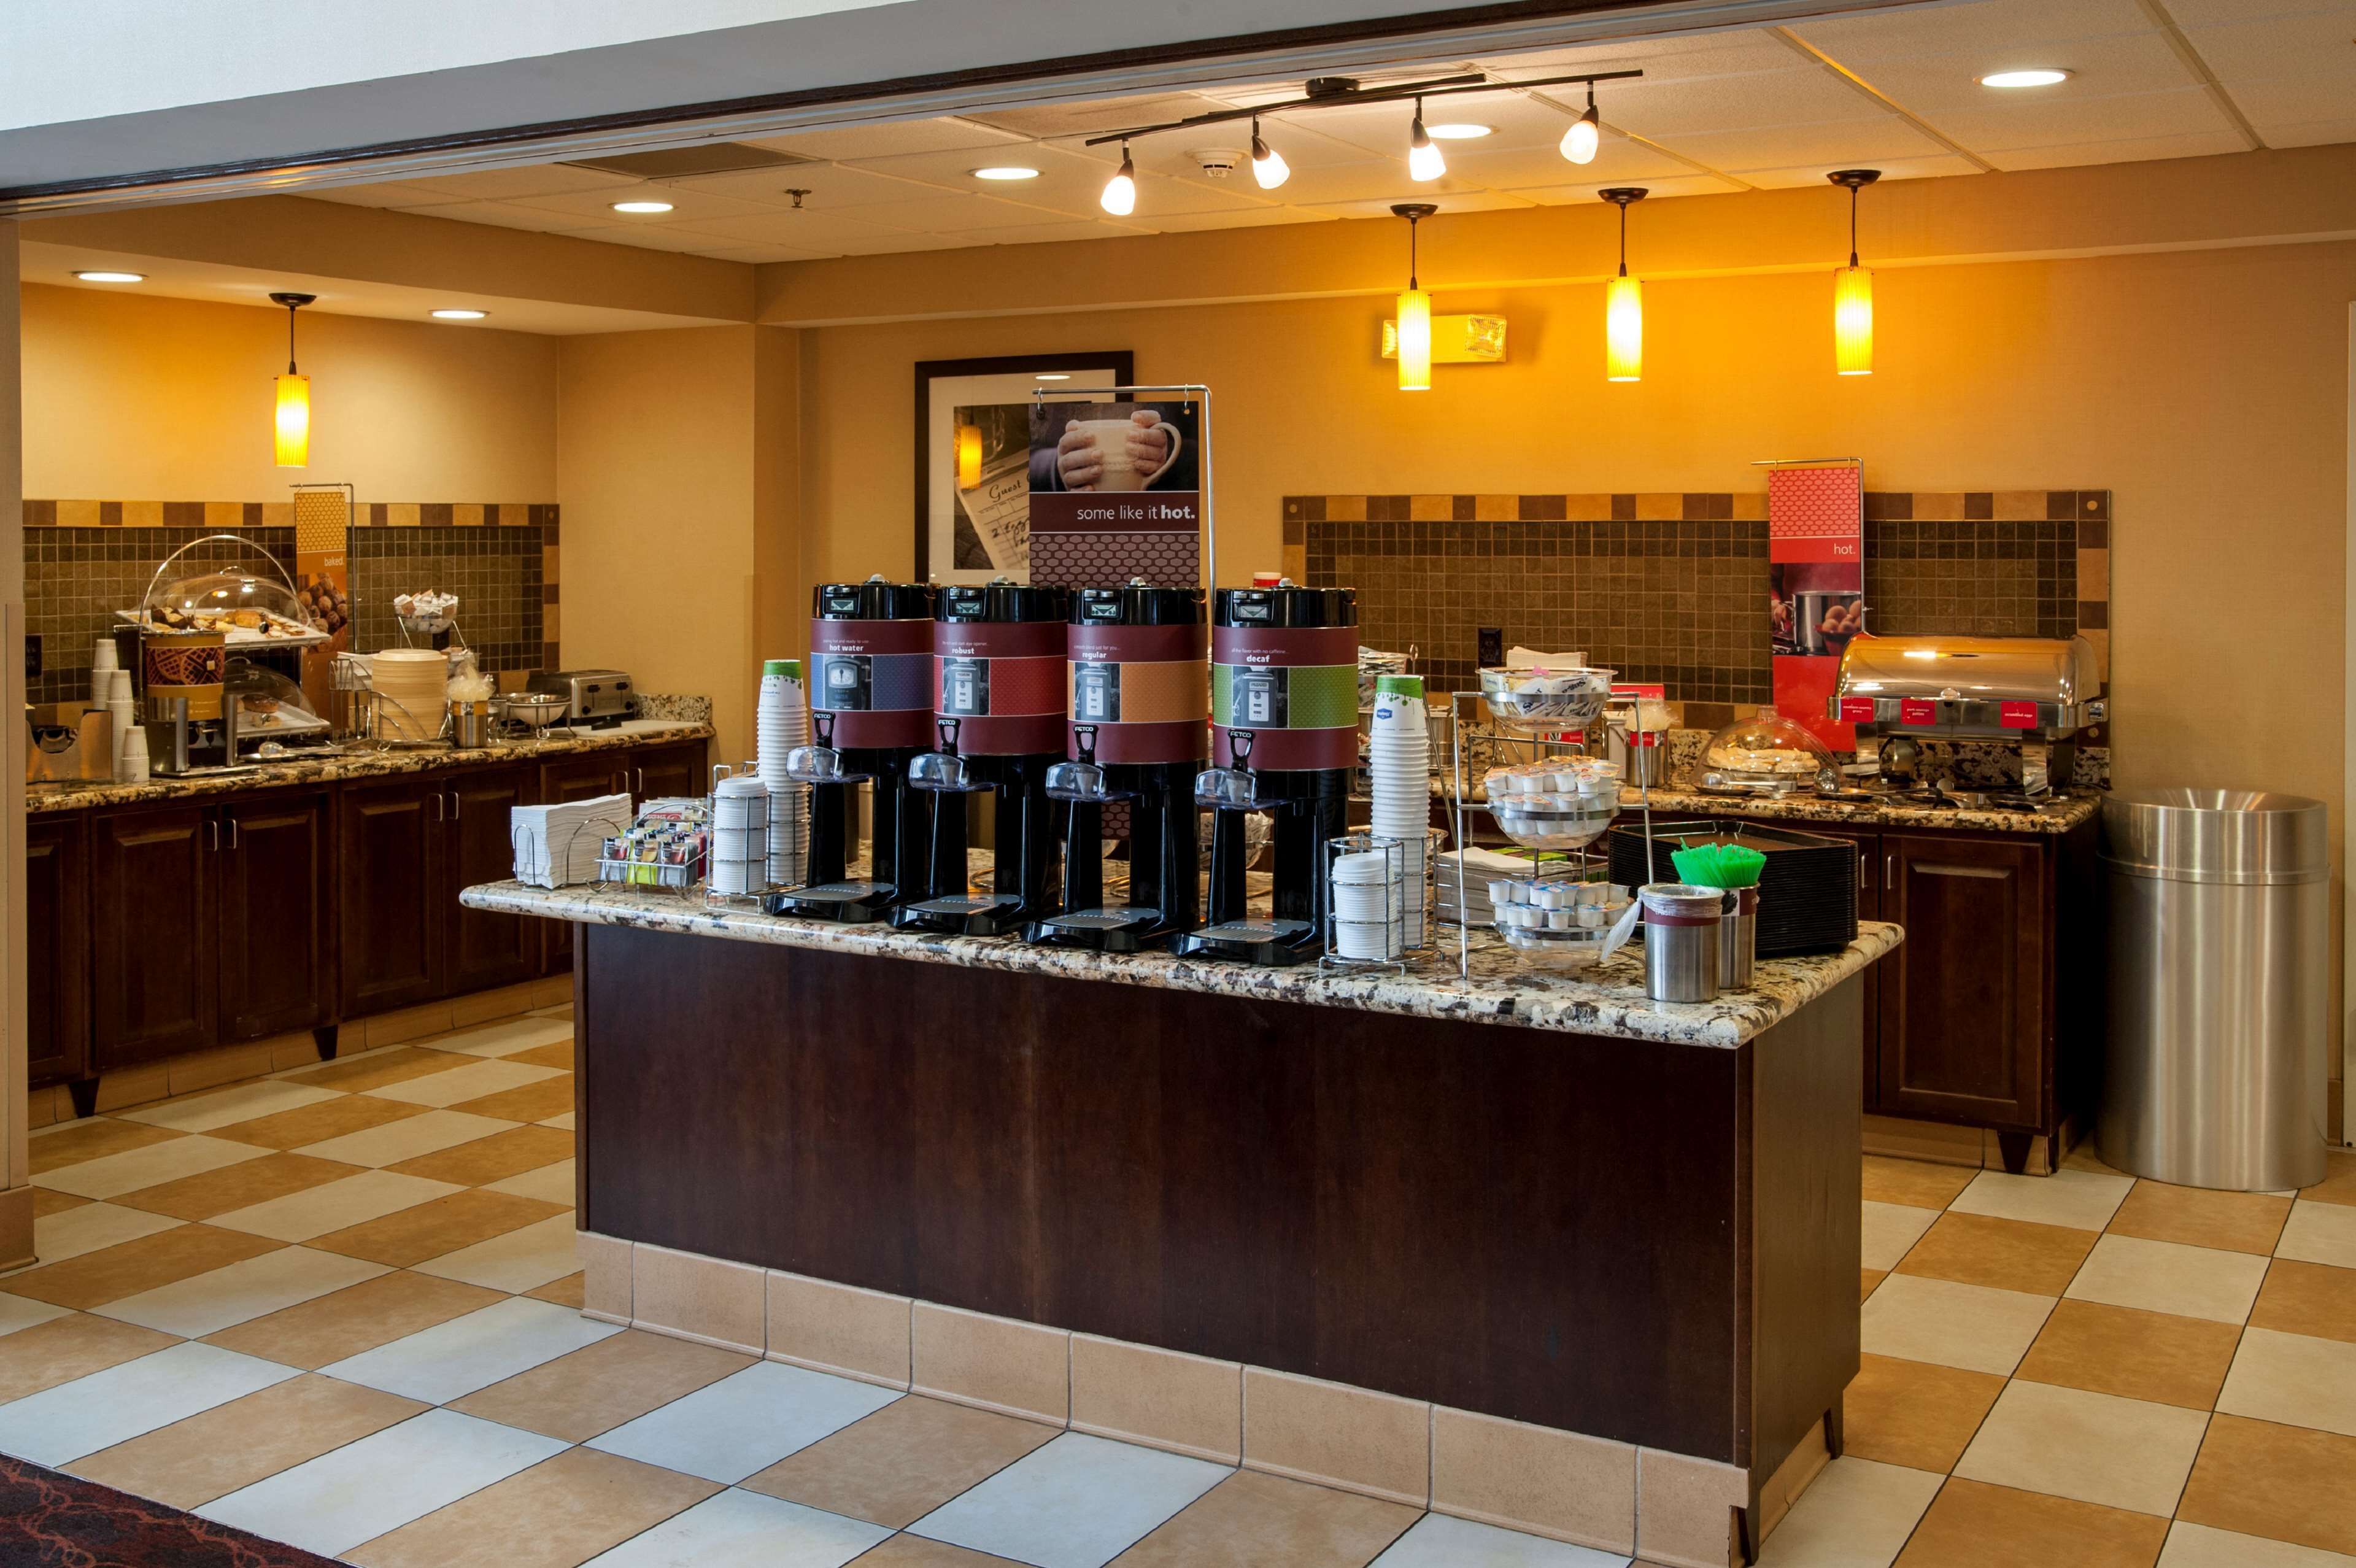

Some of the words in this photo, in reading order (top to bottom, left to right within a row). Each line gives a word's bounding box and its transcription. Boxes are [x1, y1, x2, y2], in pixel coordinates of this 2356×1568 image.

[989, 479, 1021, 503] Guest
[1077, 509, 1114, 520] some
[1120, 505, 1143, 520] like
[1148, 505, 1157, 520] it
[1161, 504, 1195, 519] hot.
[1834, 543, 1856, 555] hot.
